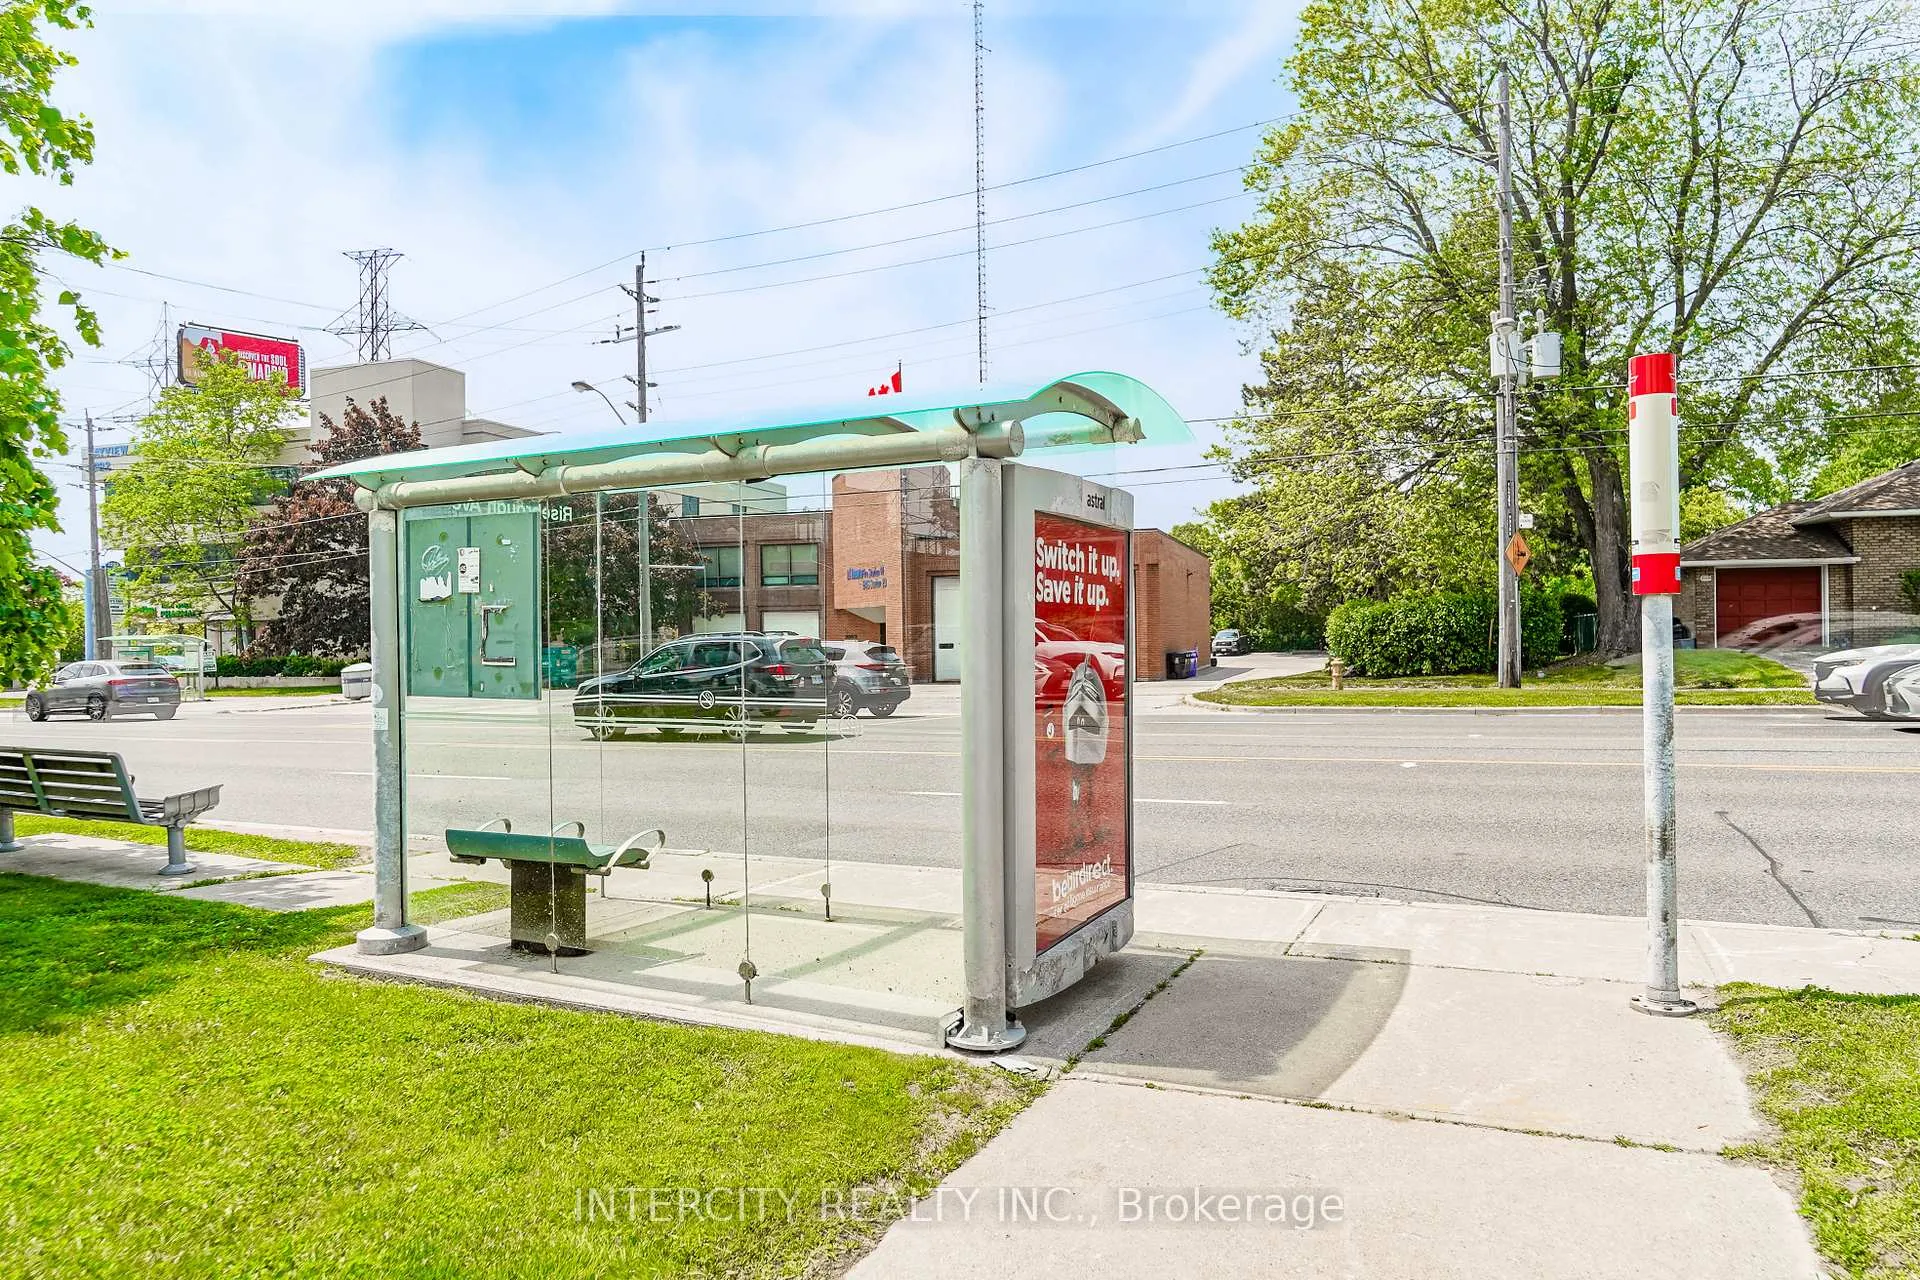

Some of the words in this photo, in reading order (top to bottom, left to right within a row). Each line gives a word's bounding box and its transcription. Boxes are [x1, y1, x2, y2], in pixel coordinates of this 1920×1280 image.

[271, 354, 288, 367] SOUL
[1086, 493, 1106, 511] astral
[1035, 536, 1085, 573] Switch
[1088, 545, 1098, 575] it
[1101, 554, 1120, 582] up.
[1035, 571, 1071, 603] Save
[1073, 575, 1084, 605] it
[1087, 583, 1109, 611] up.
